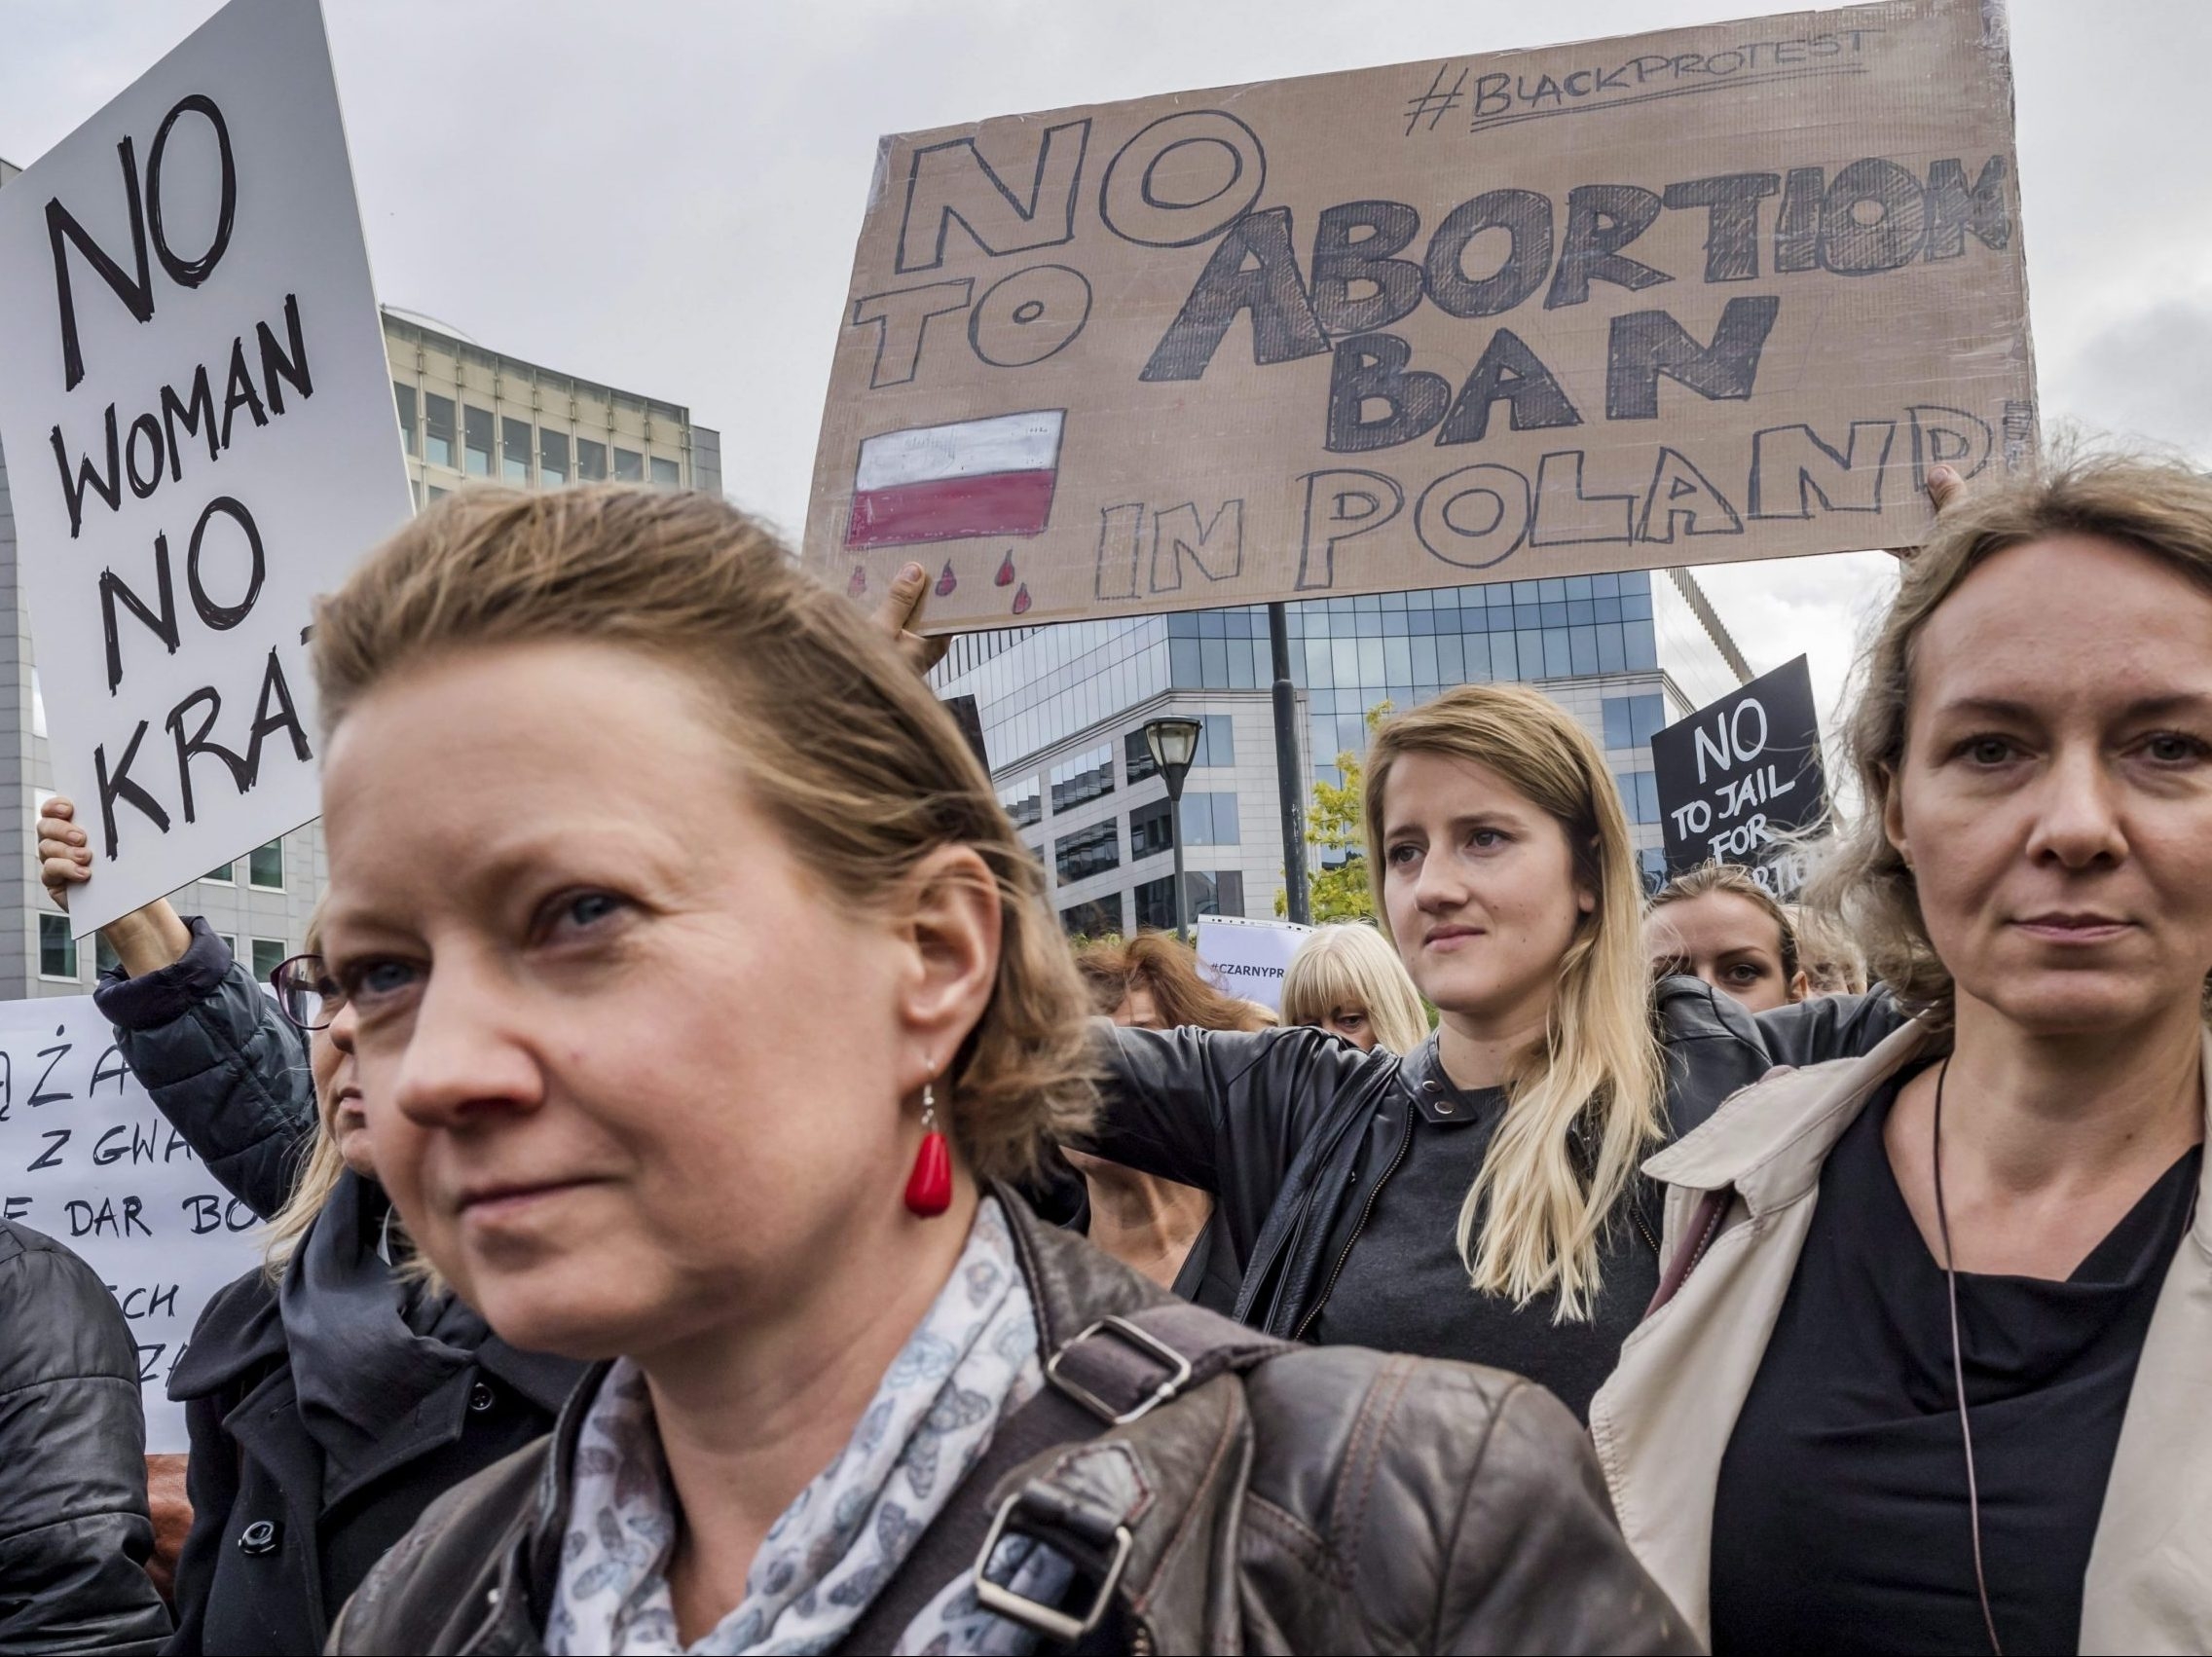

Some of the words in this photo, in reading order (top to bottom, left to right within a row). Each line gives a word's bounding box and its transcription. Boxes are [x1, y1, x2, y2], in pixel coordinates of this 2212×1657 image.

[1404, 27, 1885, 135] #BLACKPROTEST
[45, 93, 237, 391] NO
[895, 109, 1266, 275] NO
[852, 264, 1092, 389] TO
[1138, 155, 2013, 382] ABORTION
[50, 293, 313, 538] WOMAN
[1325, 295, 1781, 454] BAN
[99, 497, 265, 697] NO
[1095, 499, 1243, 600] IN
[94, 624, 317, 861] KRA
[1671, 799, 1712, 841] TO
[1714, 764, 1795, 820] JAIL
[1694, 698, 1767, 785] NO
[1708, 813, 1776, 866] FOR
[27, 1128, 72, 1172] Z
[64, 1195, 153, 1238] DAR
